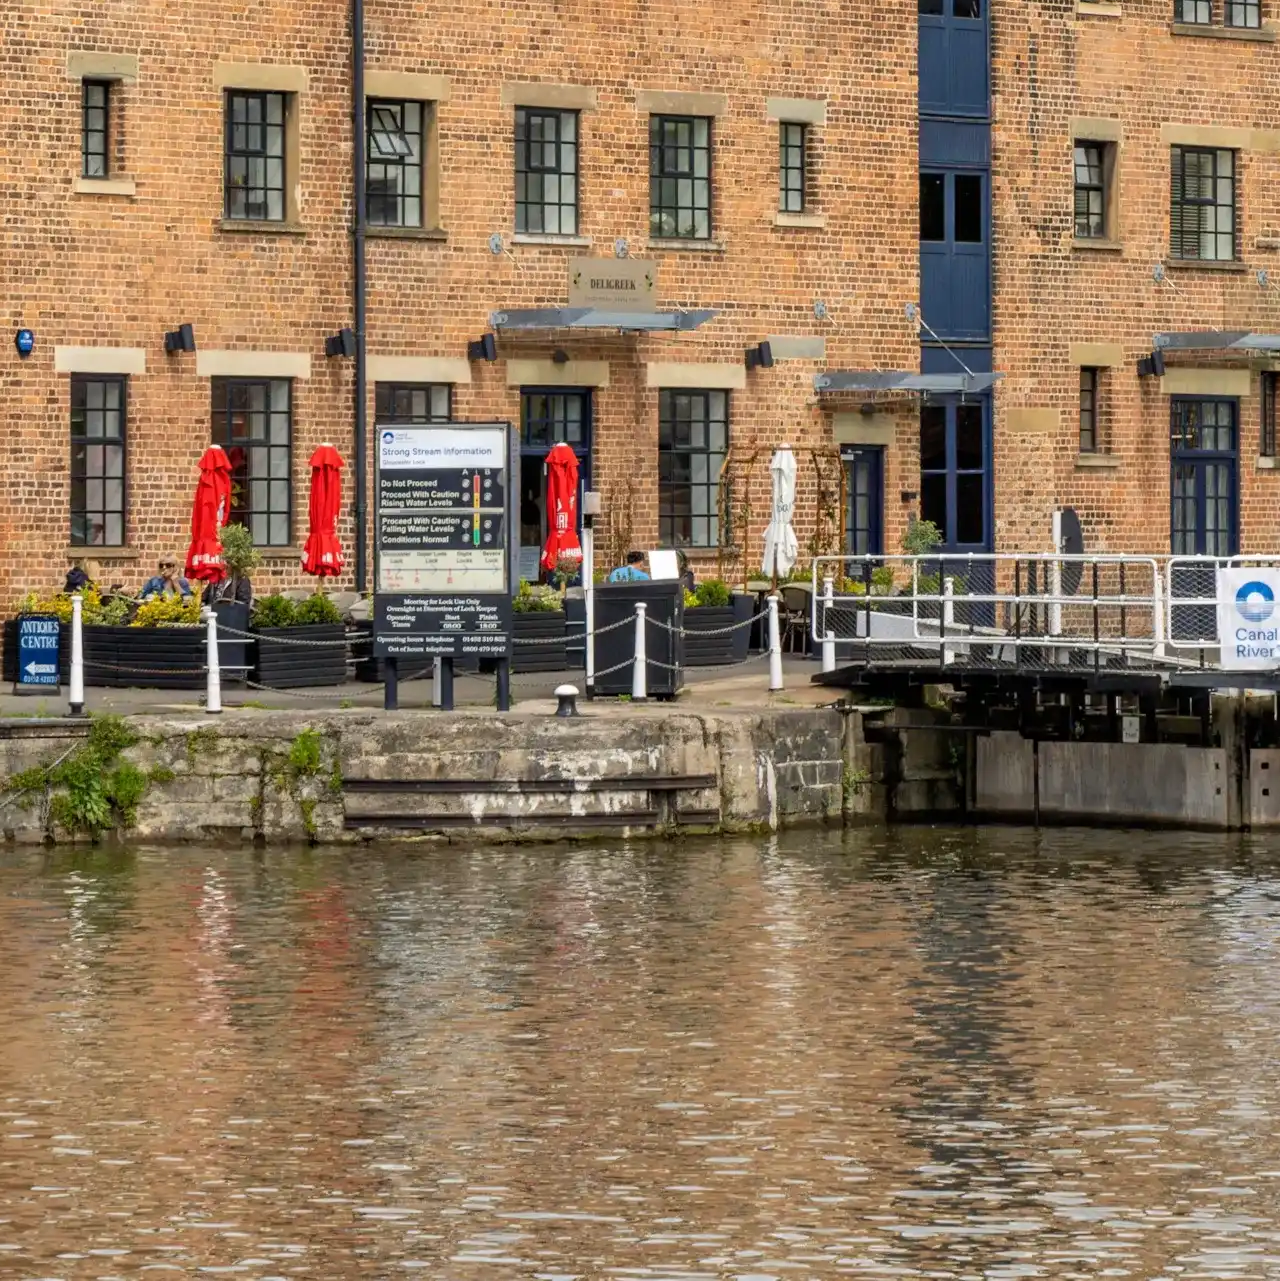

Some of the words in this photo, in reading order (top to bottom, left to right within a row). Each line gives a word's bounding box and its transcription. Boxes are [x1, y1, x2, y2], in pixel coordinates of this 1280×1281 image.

[590, 278, 636, 291] DELIGREEK
[382, 448, 410, 457] Strong
[412, 448, 442, 456] Stream
[444, 448, 492, 456] Information
[381, 480, 392, 488] Do
[381, 491, 411, 499] Proceed
[381, 500, 405, 508] Rising
[382, 525, 406, 533] Falling
[20, 621, 59, 633] ANTIQUES
[1236, 628, 1280, 641] Canal
[21, 636, 59, 648] CENTRE
[1236, 645, 1275, 657] River
